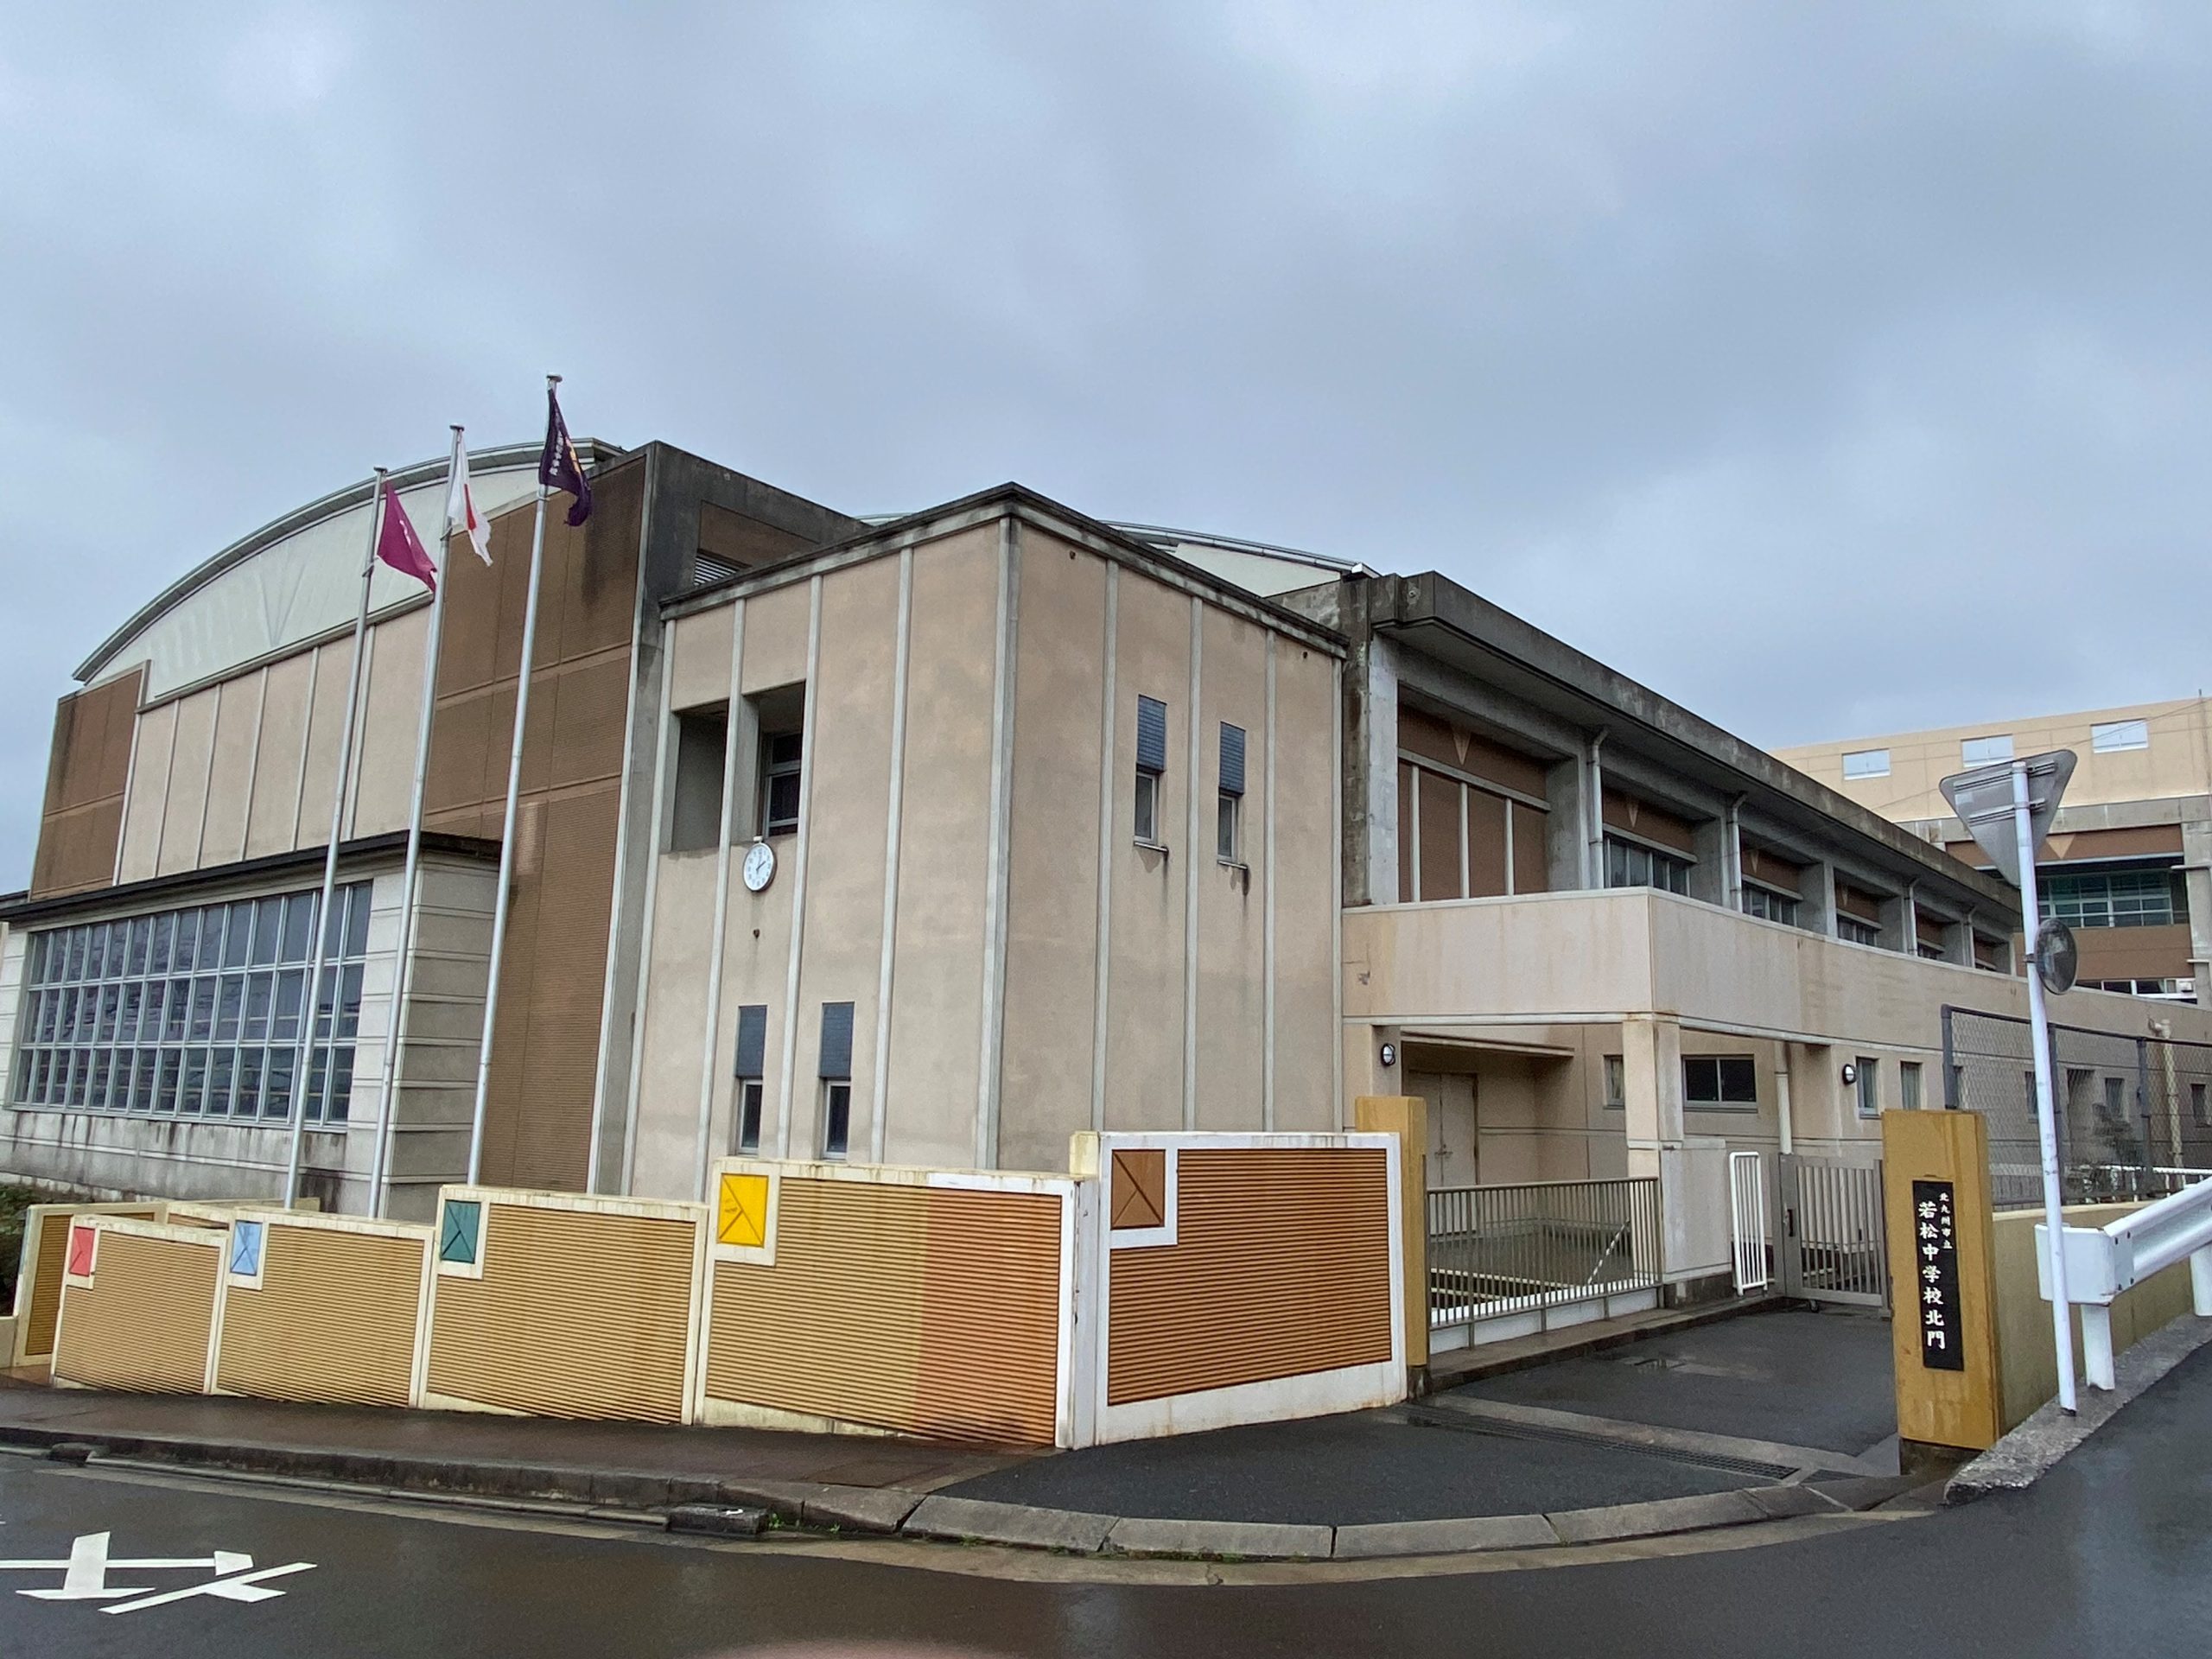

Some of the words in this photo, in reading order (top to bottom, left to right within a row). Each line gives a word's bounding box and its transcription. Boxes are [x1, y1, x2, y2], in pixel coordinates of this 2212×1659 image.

[1918, 1201, 1945, 1349] 若松中学校北門
